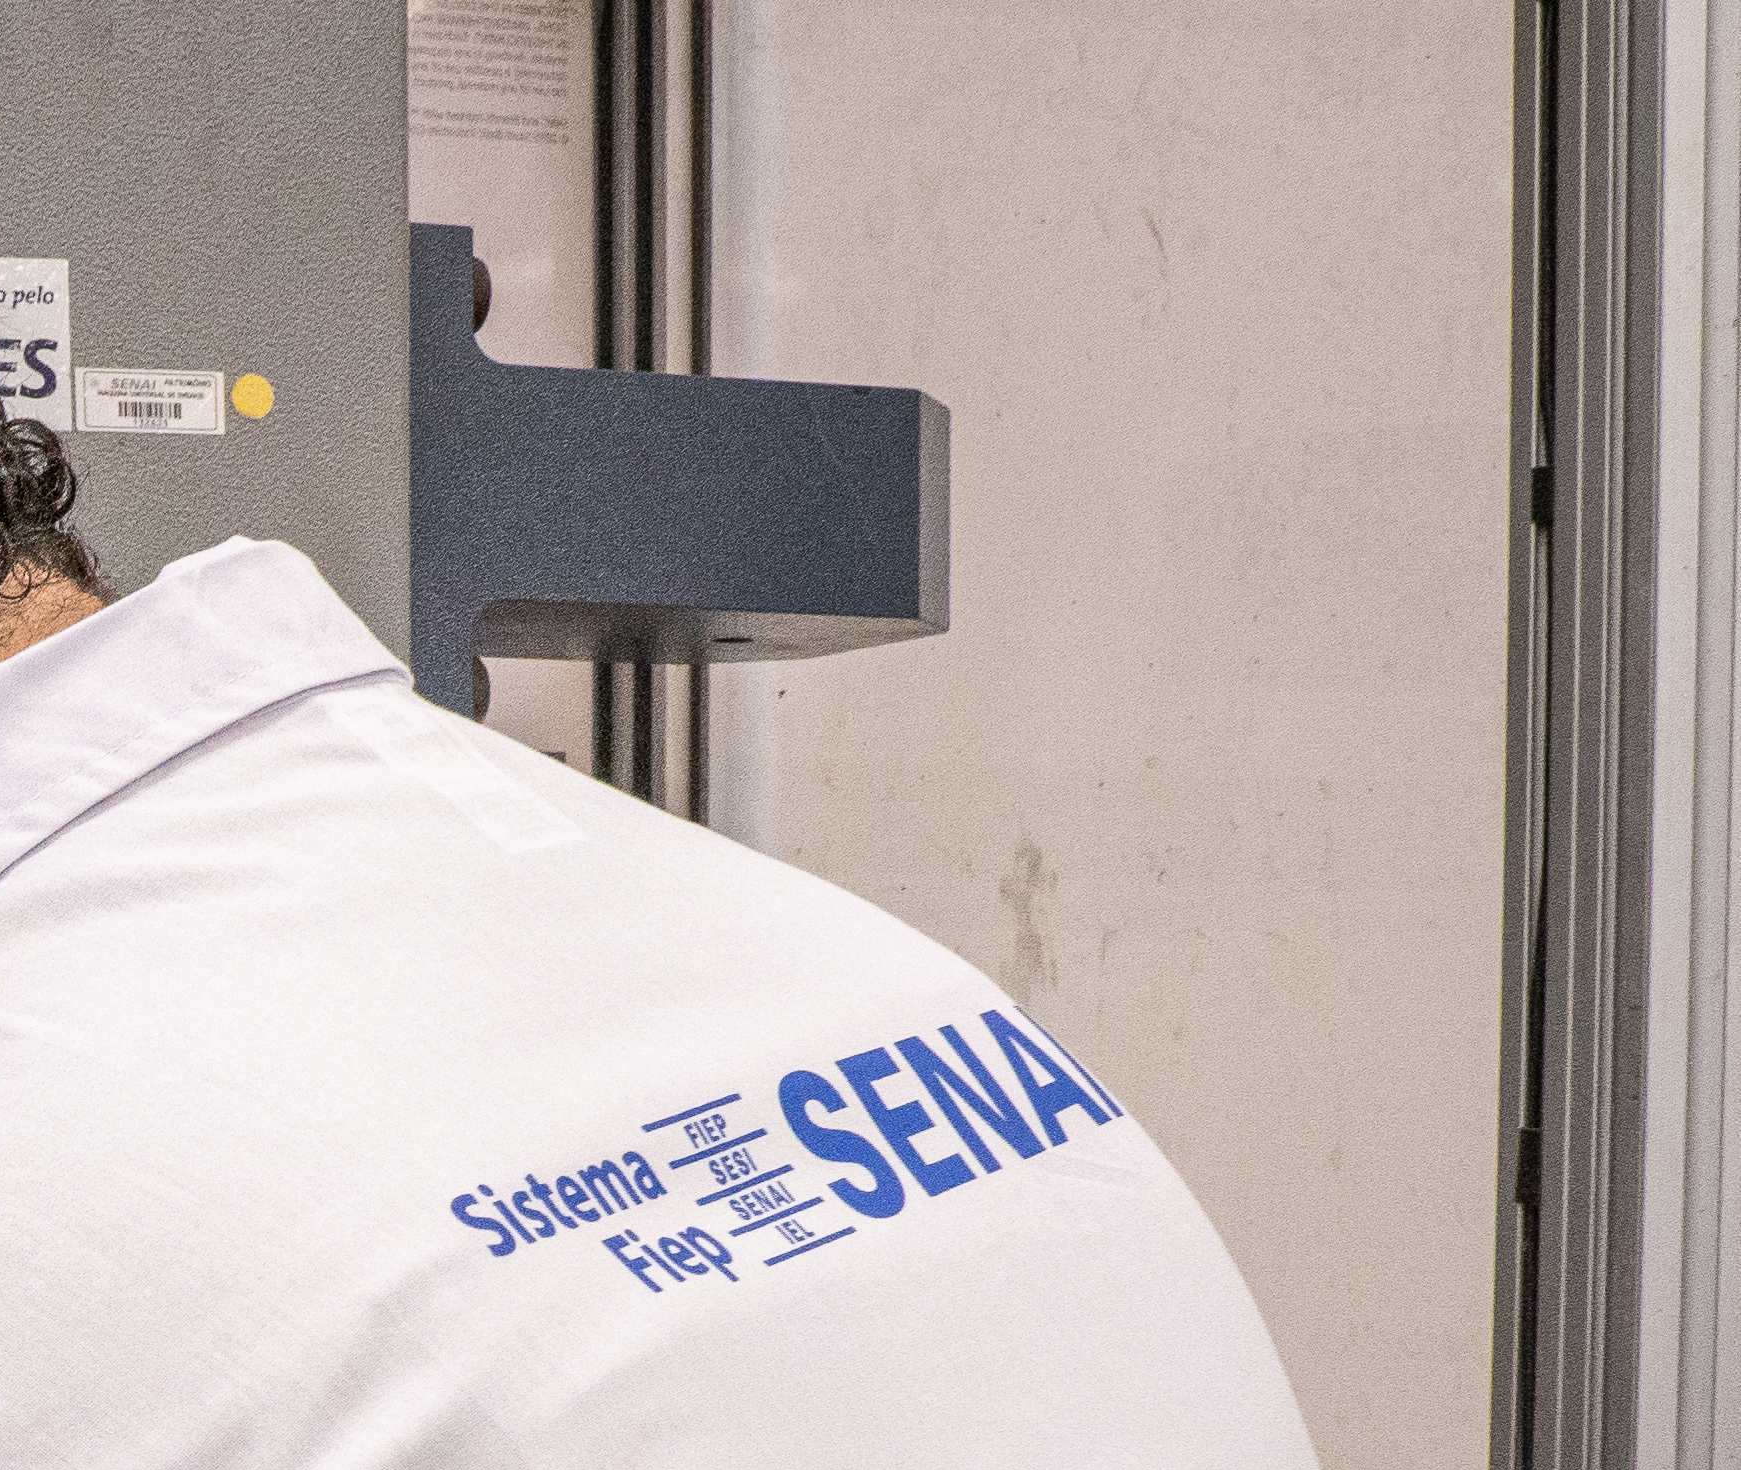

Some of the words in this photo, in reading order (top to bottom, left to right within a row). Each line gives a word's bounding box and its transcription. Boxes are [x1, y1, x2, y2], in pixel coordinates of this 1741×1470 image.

[12, 285, 55, 309] pelo
[110, 378, 157, 390] SENAI
[684, 1113, 728, 1147] FIEP
[707, 1147, 757, 1186] SESI
[450, 1144, 668, 1259] Sistema
[729, 1182, 794, 1222] SENAI
[777, 1219, 814, 1245] IEL
[603, 1220, 739, 1295] Fiep
